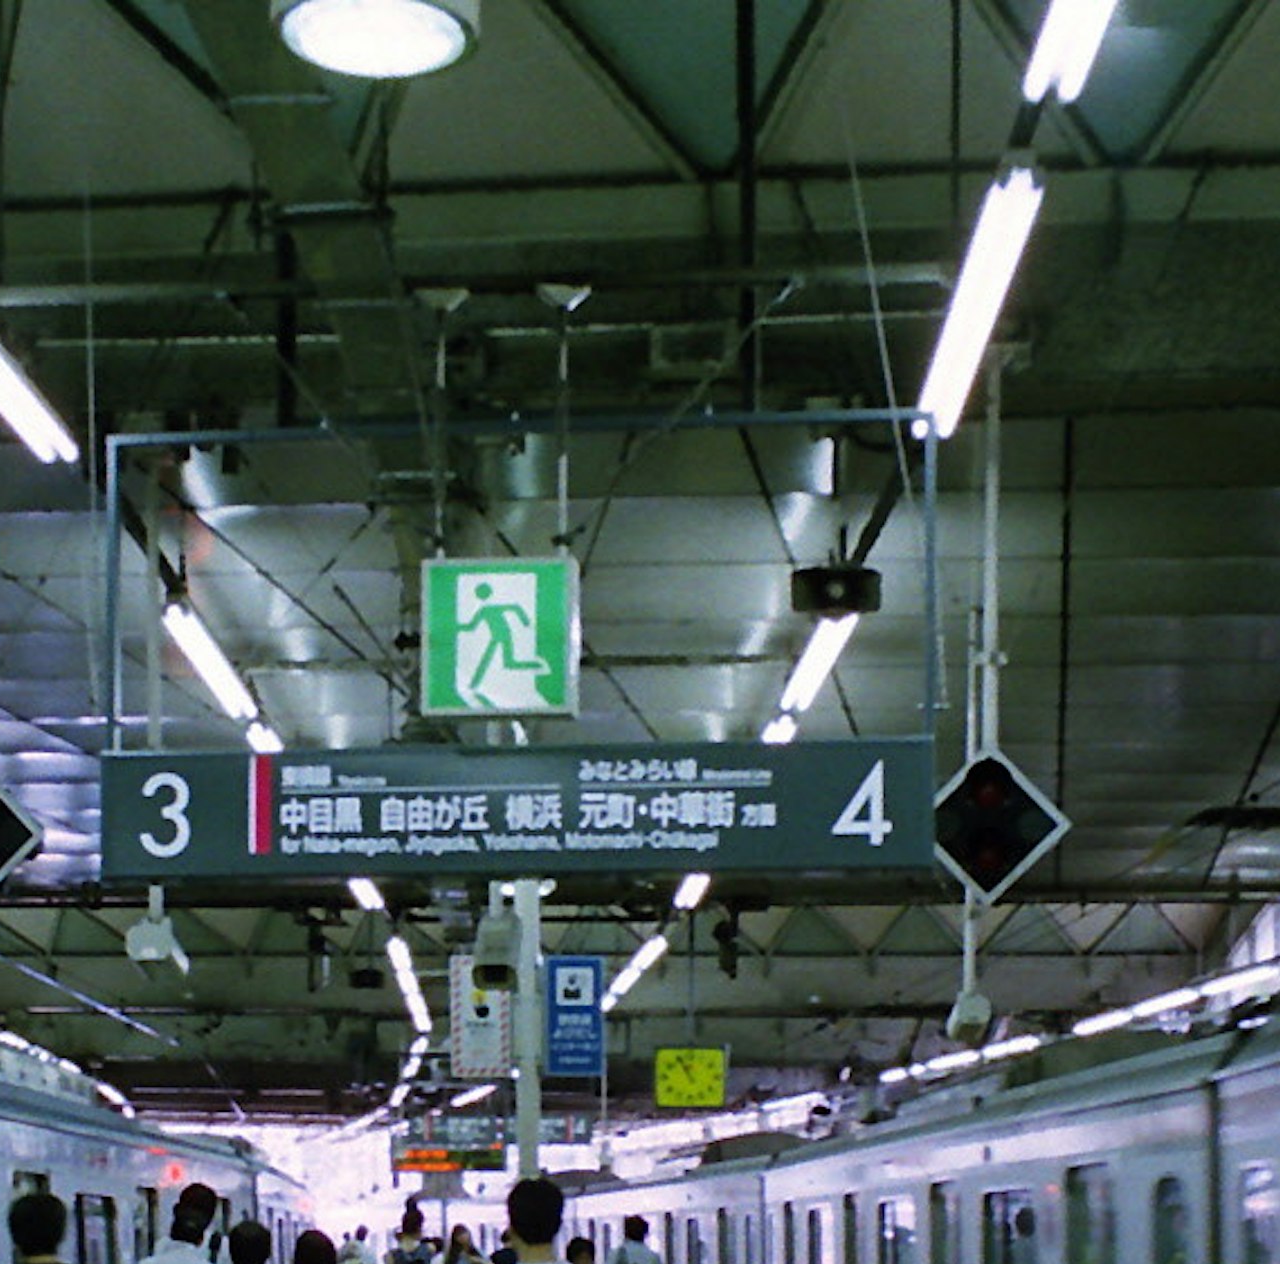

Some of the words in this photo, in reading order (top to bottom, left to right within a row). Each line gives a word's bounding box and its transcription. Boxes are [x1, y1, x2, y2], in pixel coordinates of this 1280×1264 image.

[140, 771, 191, 858] 3
[280, 797, 362, 833] 中目黒
[380, 795, 490, 832] 自由が丘
[506, 793, 562, 830] 横浜
[831, 758, 894, 846] 4
